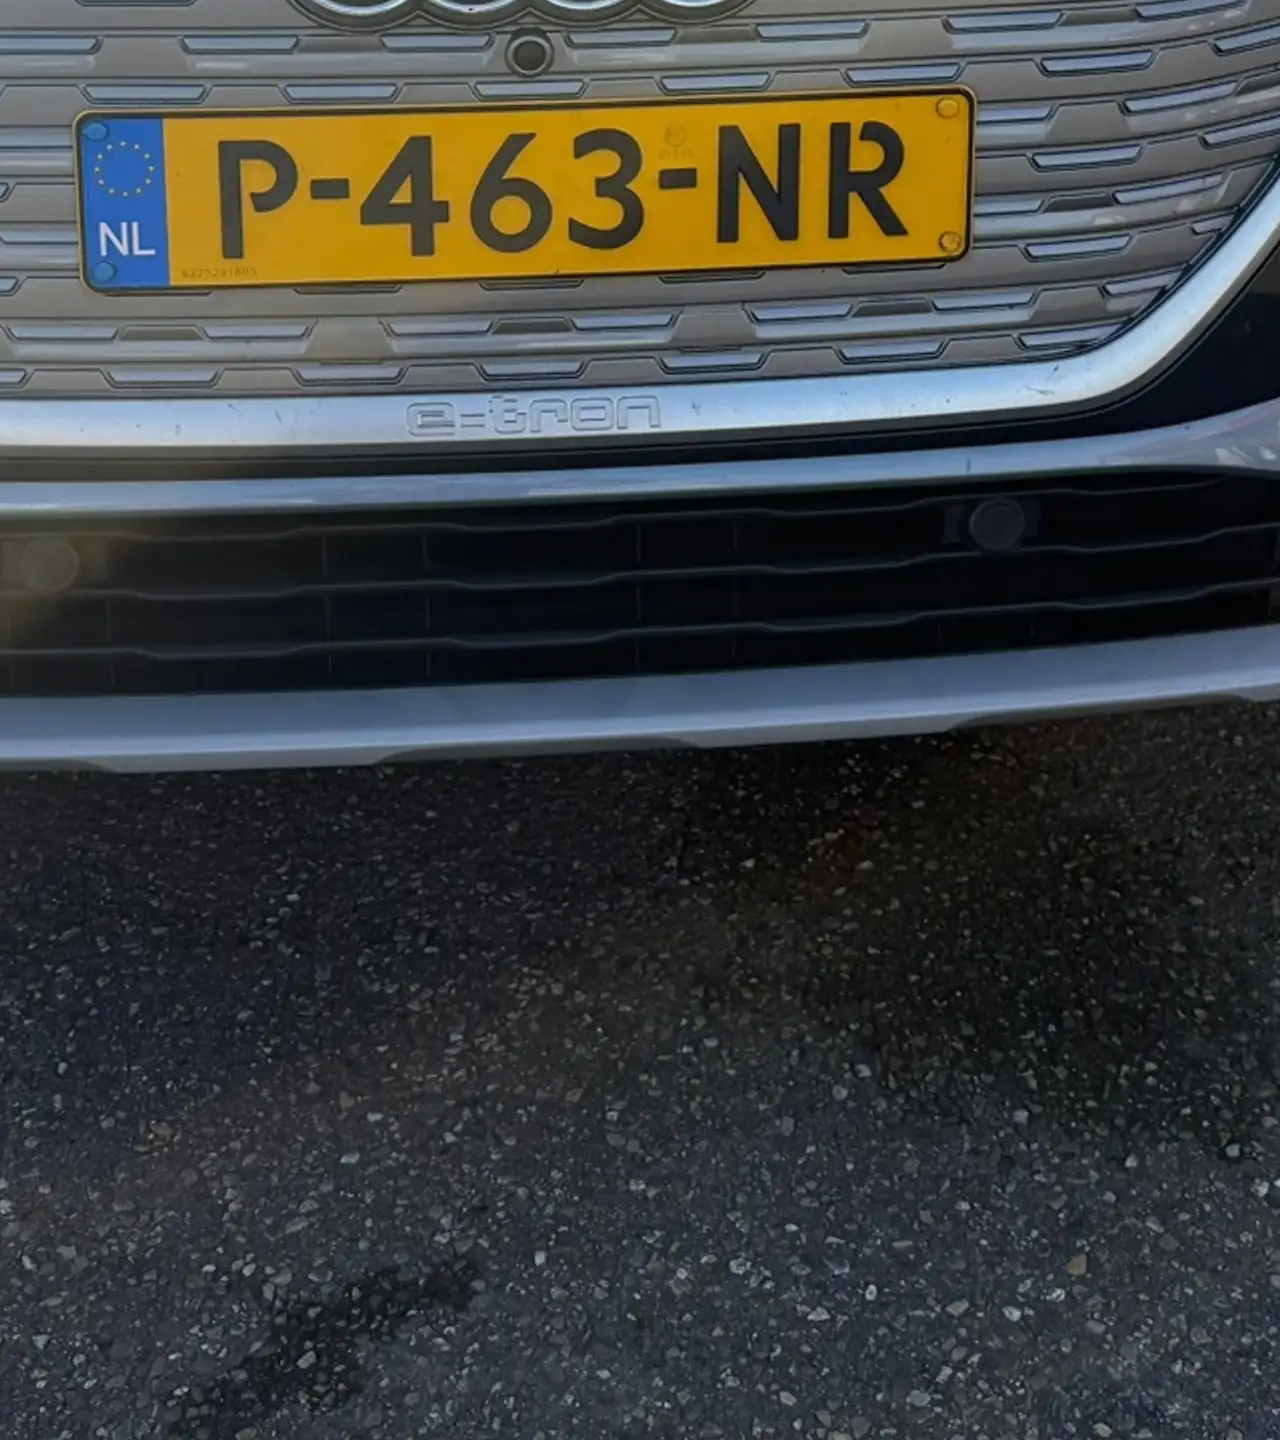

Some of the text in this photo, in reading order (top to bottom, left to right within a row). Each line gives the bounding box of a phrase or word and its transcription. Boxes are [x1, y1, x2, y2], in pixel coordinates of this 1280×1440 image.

[217, 120, 908, 259] P-463-NR
[99, 221, 157, 258] NL
[406, 394, 662, 438] e-tron
